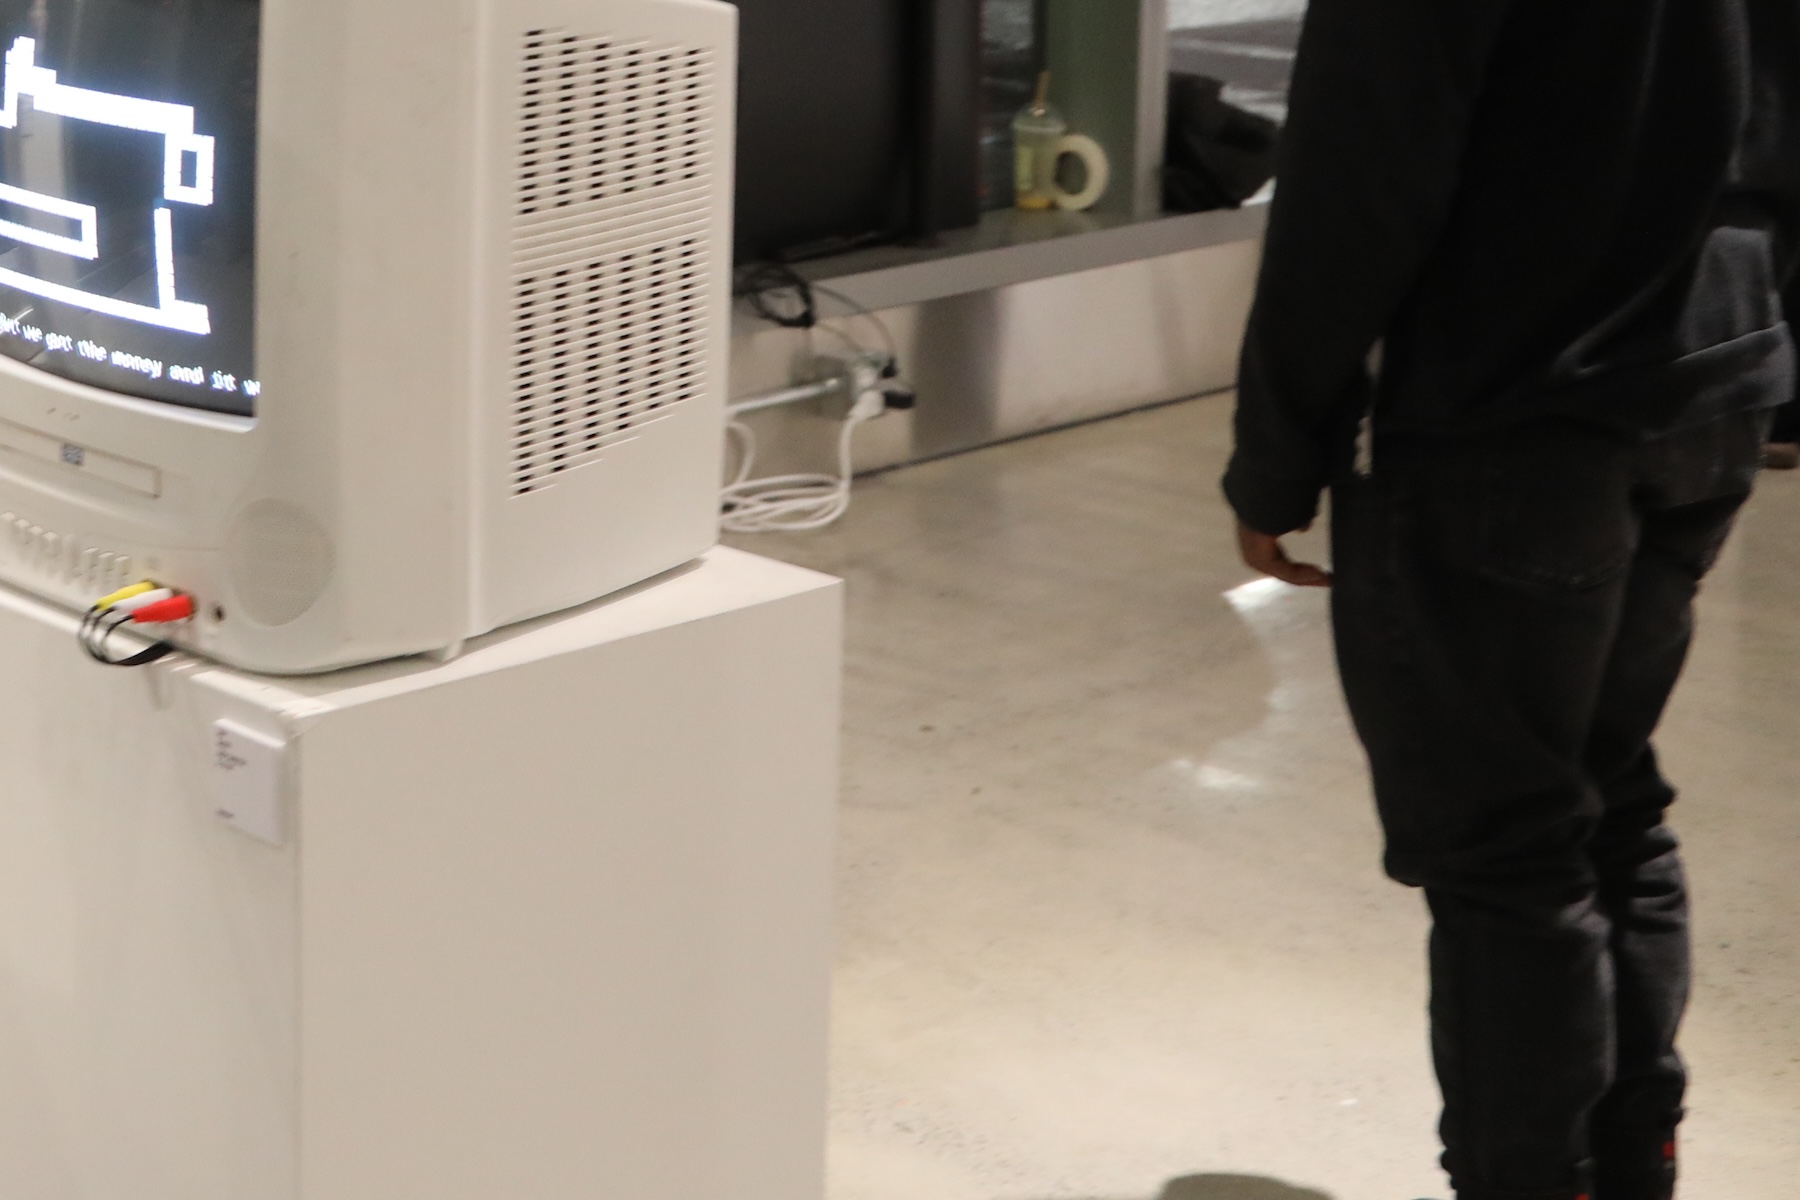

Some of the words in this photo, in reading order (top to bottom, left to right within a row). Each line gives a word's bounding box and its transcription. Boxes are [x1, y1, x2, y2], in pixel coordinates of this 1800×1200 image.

[23, 324, 43, 343] we
[45, 332, 73, 351] got
[78, 339, 107, 361] the
[111, 350, 163, 379] money
[169, 365, 205, 385] and
[212, 370, 237, 392] it
